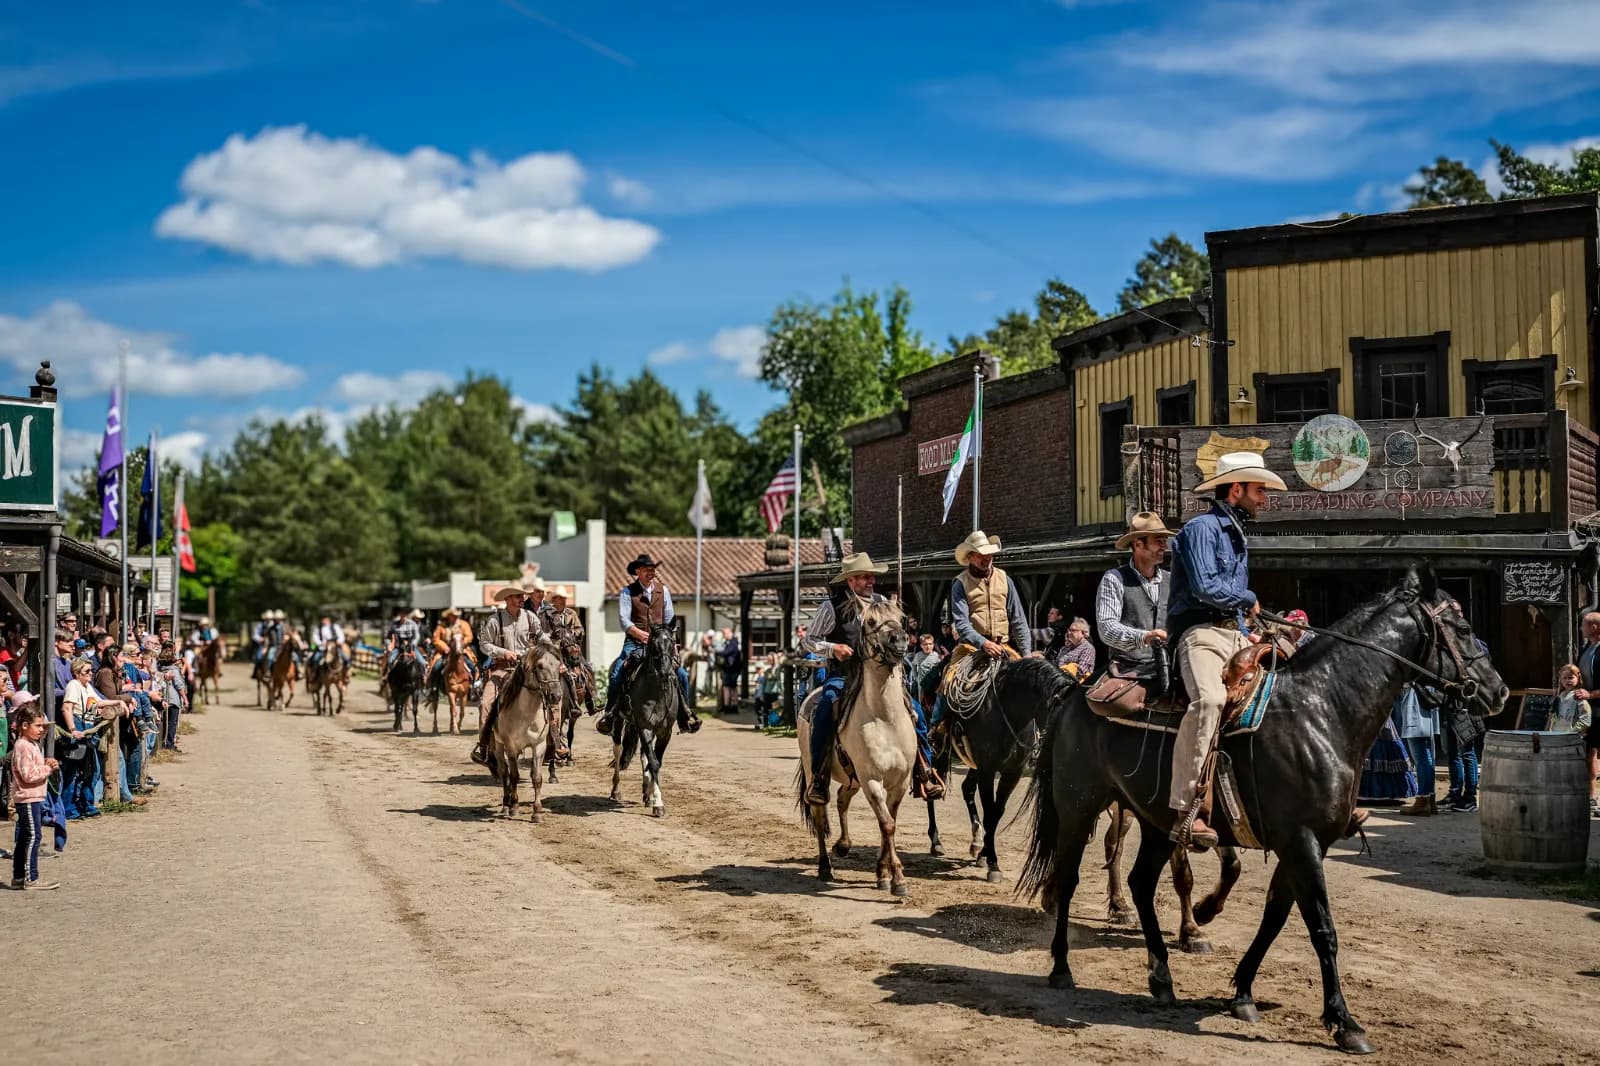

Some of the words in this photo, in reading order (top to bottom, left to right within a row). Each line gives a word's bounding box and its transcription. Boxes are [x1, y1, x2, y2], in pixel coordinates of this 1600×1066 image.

[919, 445, 938, 471] FOOD
[1287, 493, 1377, 511] TRADING
[1383, 490, 1488, 511] COMPANY
